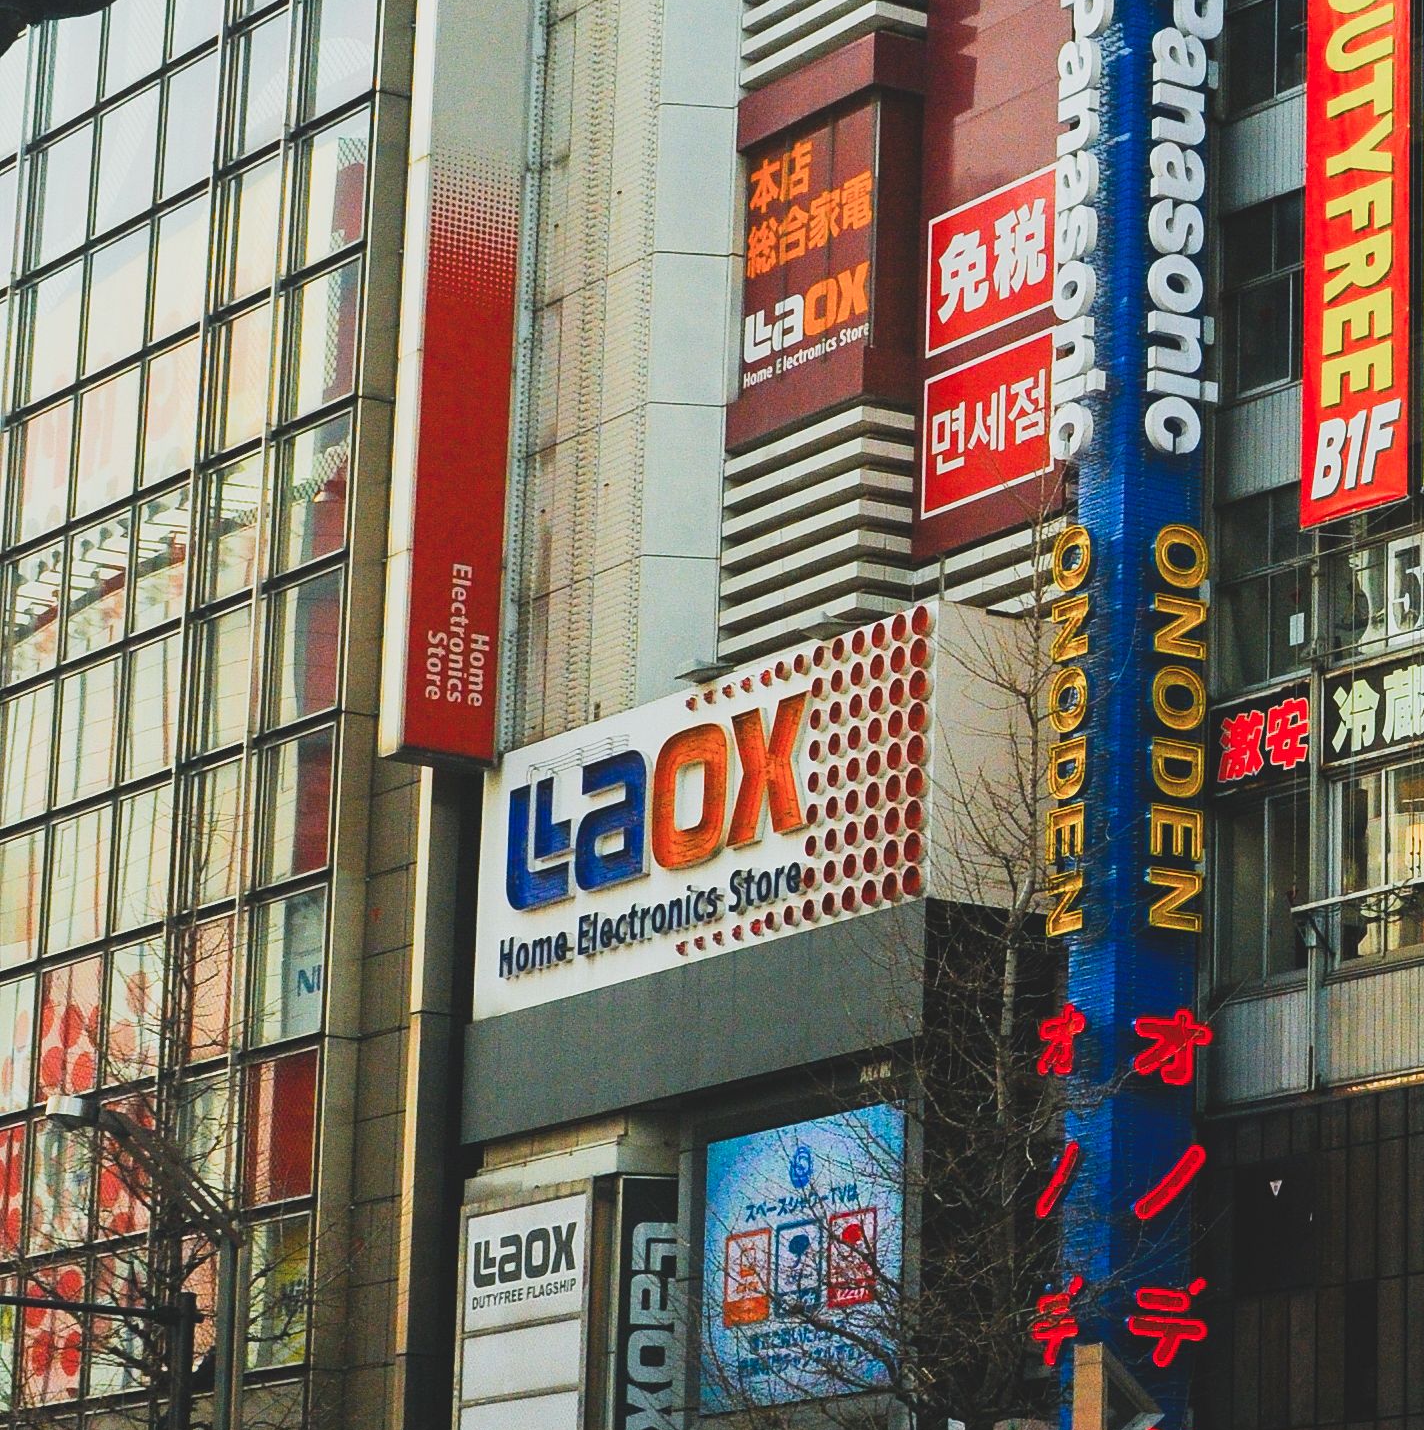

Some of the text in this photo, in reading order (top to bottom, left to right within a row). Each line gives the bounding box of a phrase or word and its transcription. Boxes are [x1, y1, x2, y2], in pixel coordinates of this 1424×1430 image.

[746, 170, 874, 280] 総合家電
[749, 139, 814, 214] 本店
[938, 196, 1048, 325] 免税
[742, 321, 870, 390] Home Electronics Store
[931, 368, 1048, 476] 면세점
[1310, 396, 1402, 503] B1F
[424, 629, 447, 703] Store
[446, 563, 473, 705] Electronics
[470, 632, 490, 708] Home
[1045, 523, 1092, 938] ONODEN
[1148, 522, 1210, 934] ONODEN
[1217, 696, 1311, 784] 激安
[498, 861, 803, 979] Home Electronics Store
[471, 1277, 577, 1311] DUTYFREE FLAGSHIP
